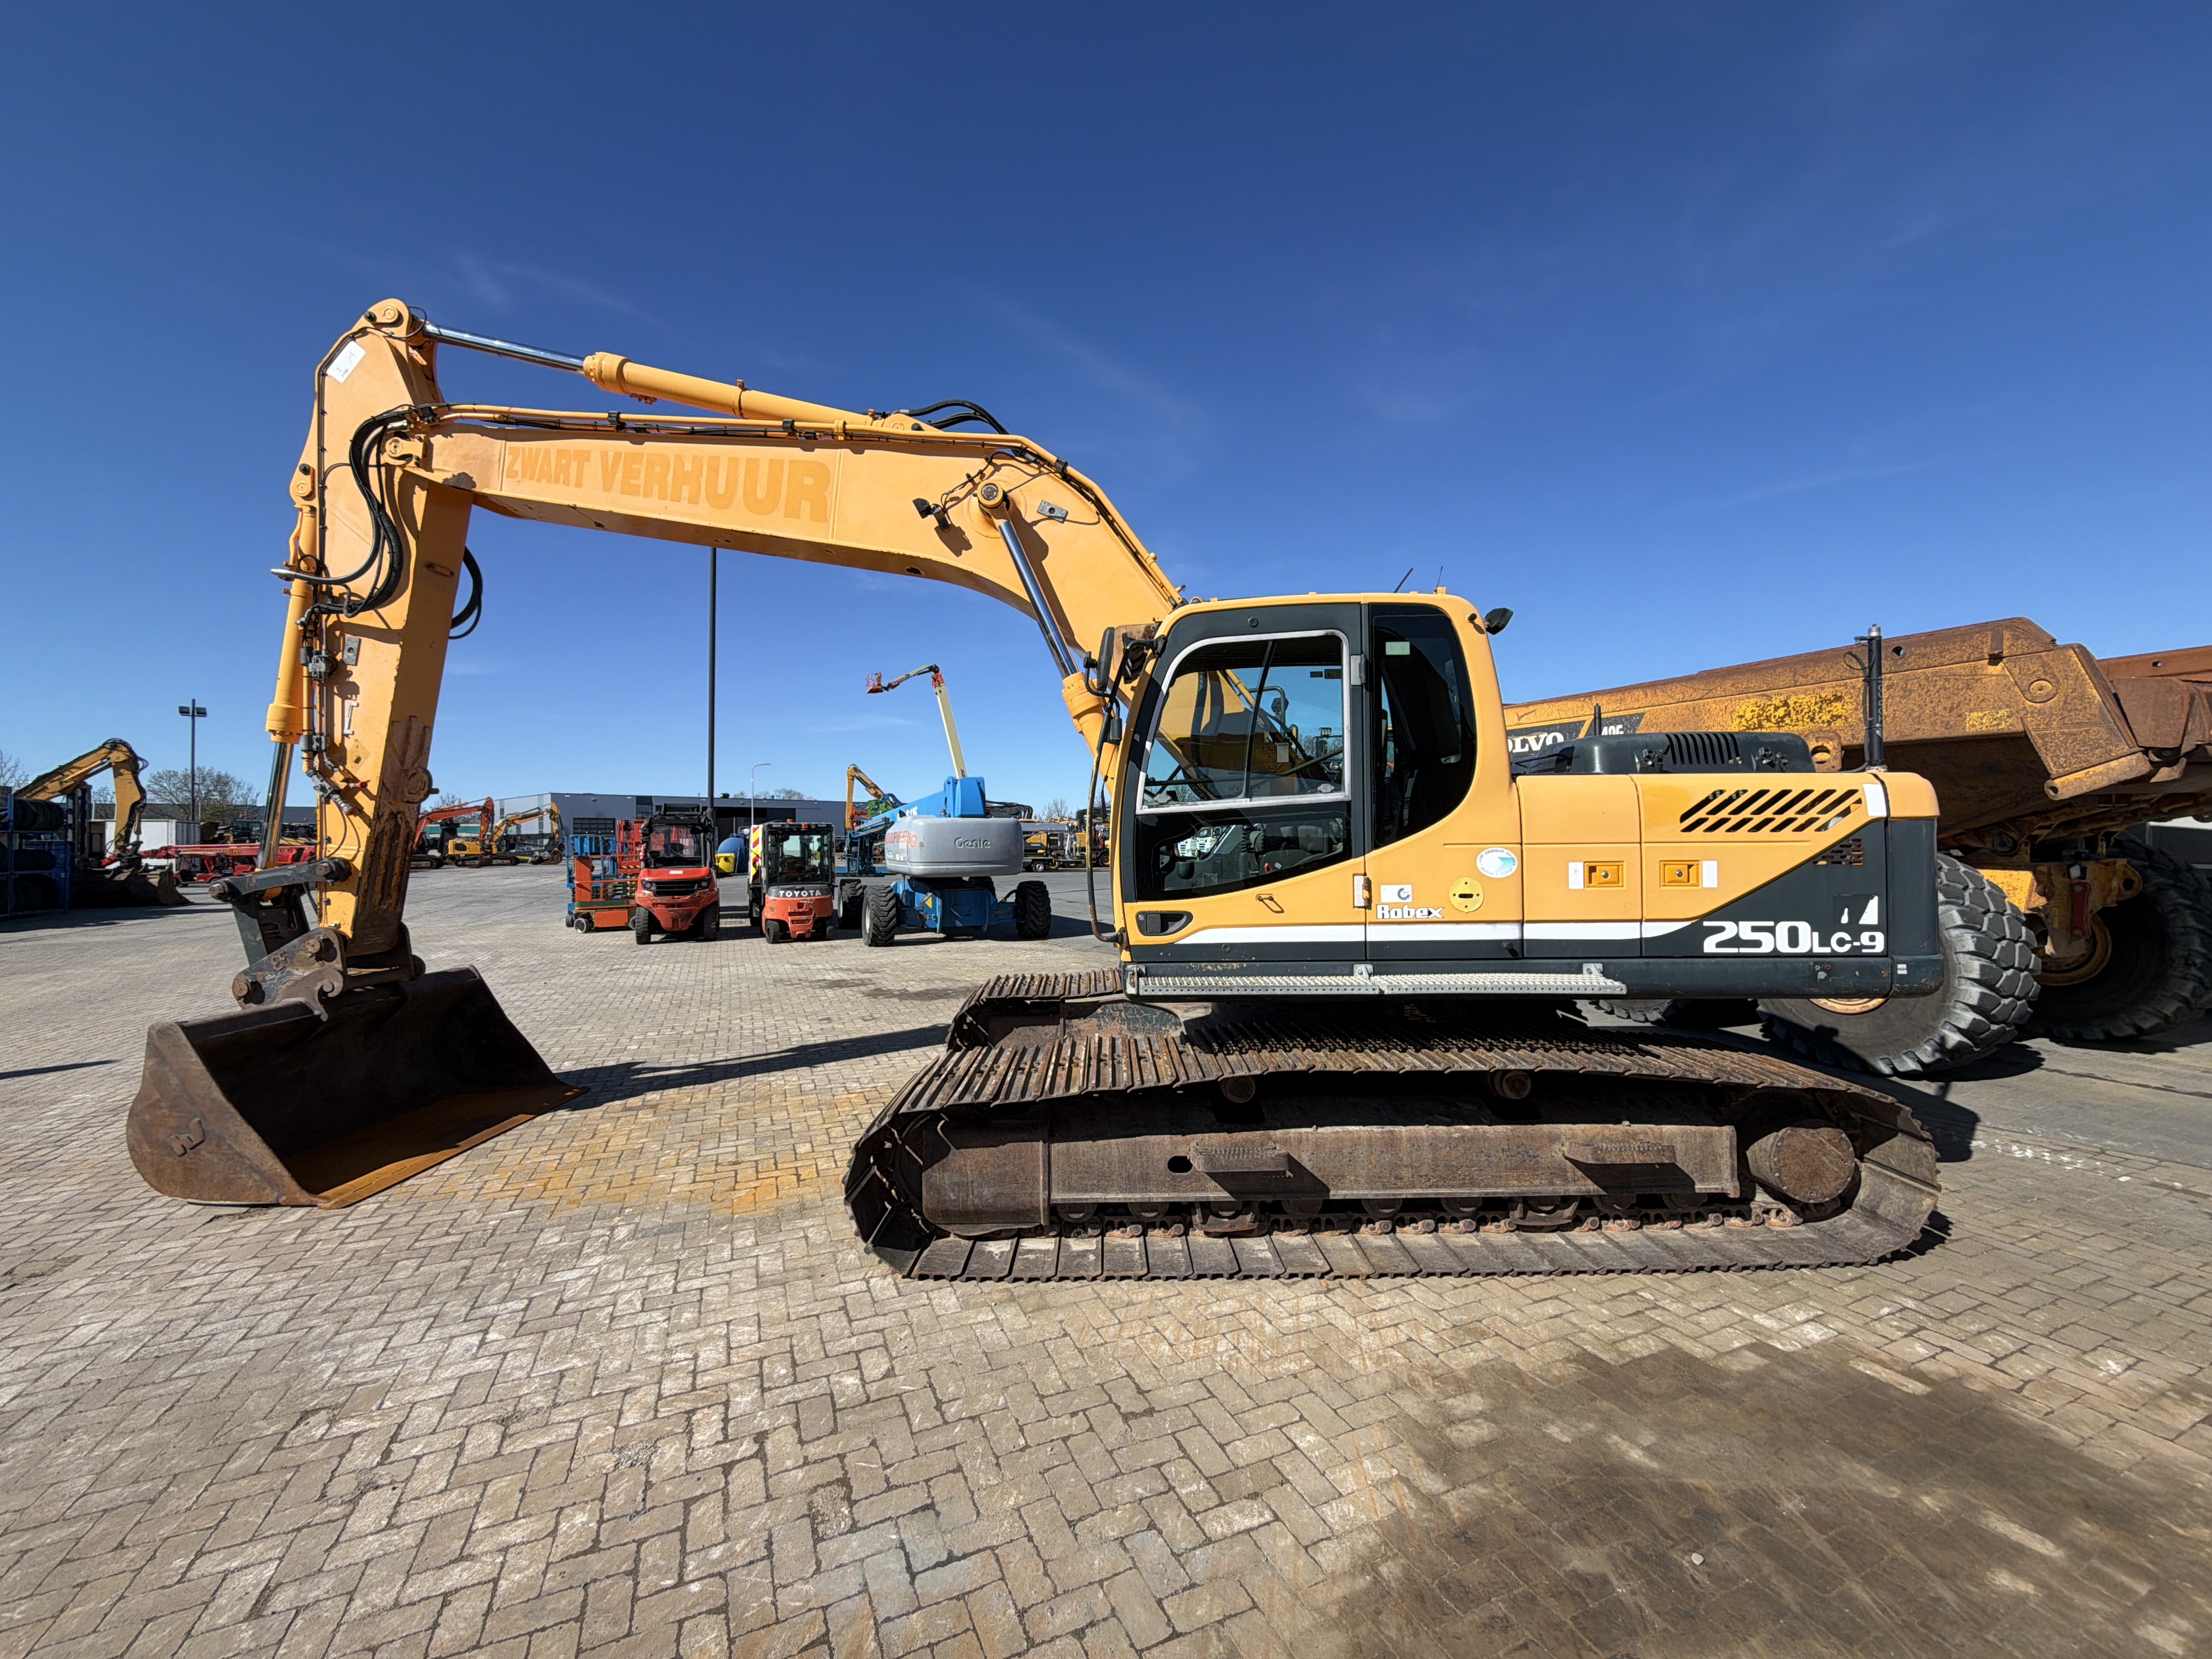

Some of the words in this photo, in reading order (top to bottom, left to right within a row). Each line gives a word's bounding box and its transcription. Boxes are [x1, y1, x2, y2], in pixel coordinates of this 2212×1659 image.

[505, 446, 590, 488] ZWART
[600, 452, 831, 523] VERHUUR
[954, 837, 991, 849] Genie
[1376, 904, 1444, 919] Robex
